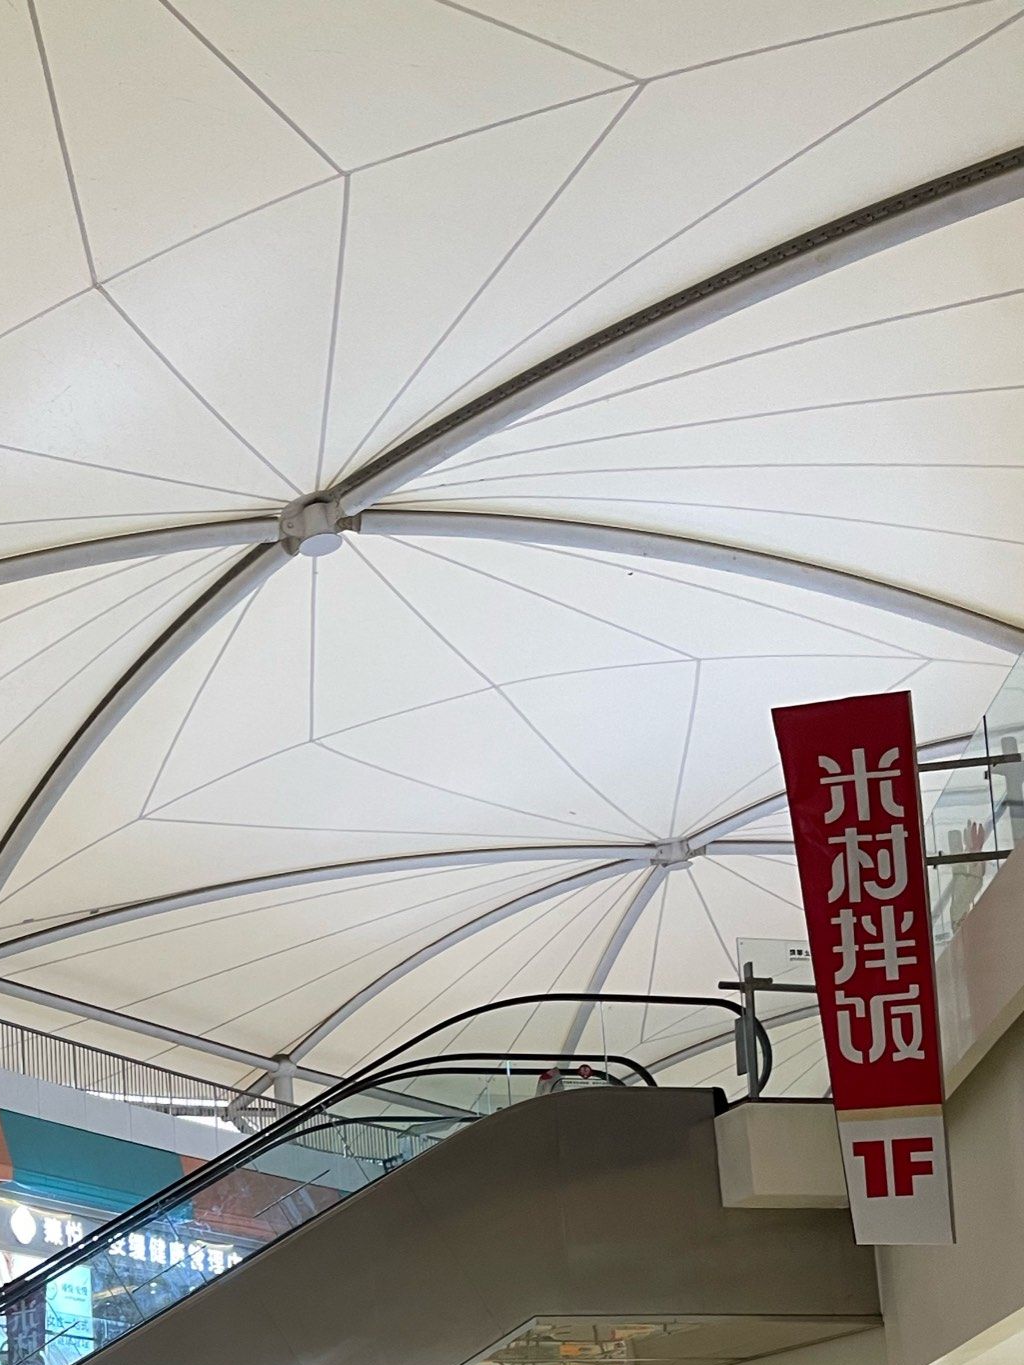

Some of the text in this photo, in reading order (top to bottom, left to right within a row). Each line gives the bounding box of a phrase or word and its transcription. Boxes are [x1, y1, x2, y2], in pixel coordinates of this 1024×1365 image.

[817, 746, 926, 1065] 米村拌饭
[852, 1137, 934, 1199] 1F
